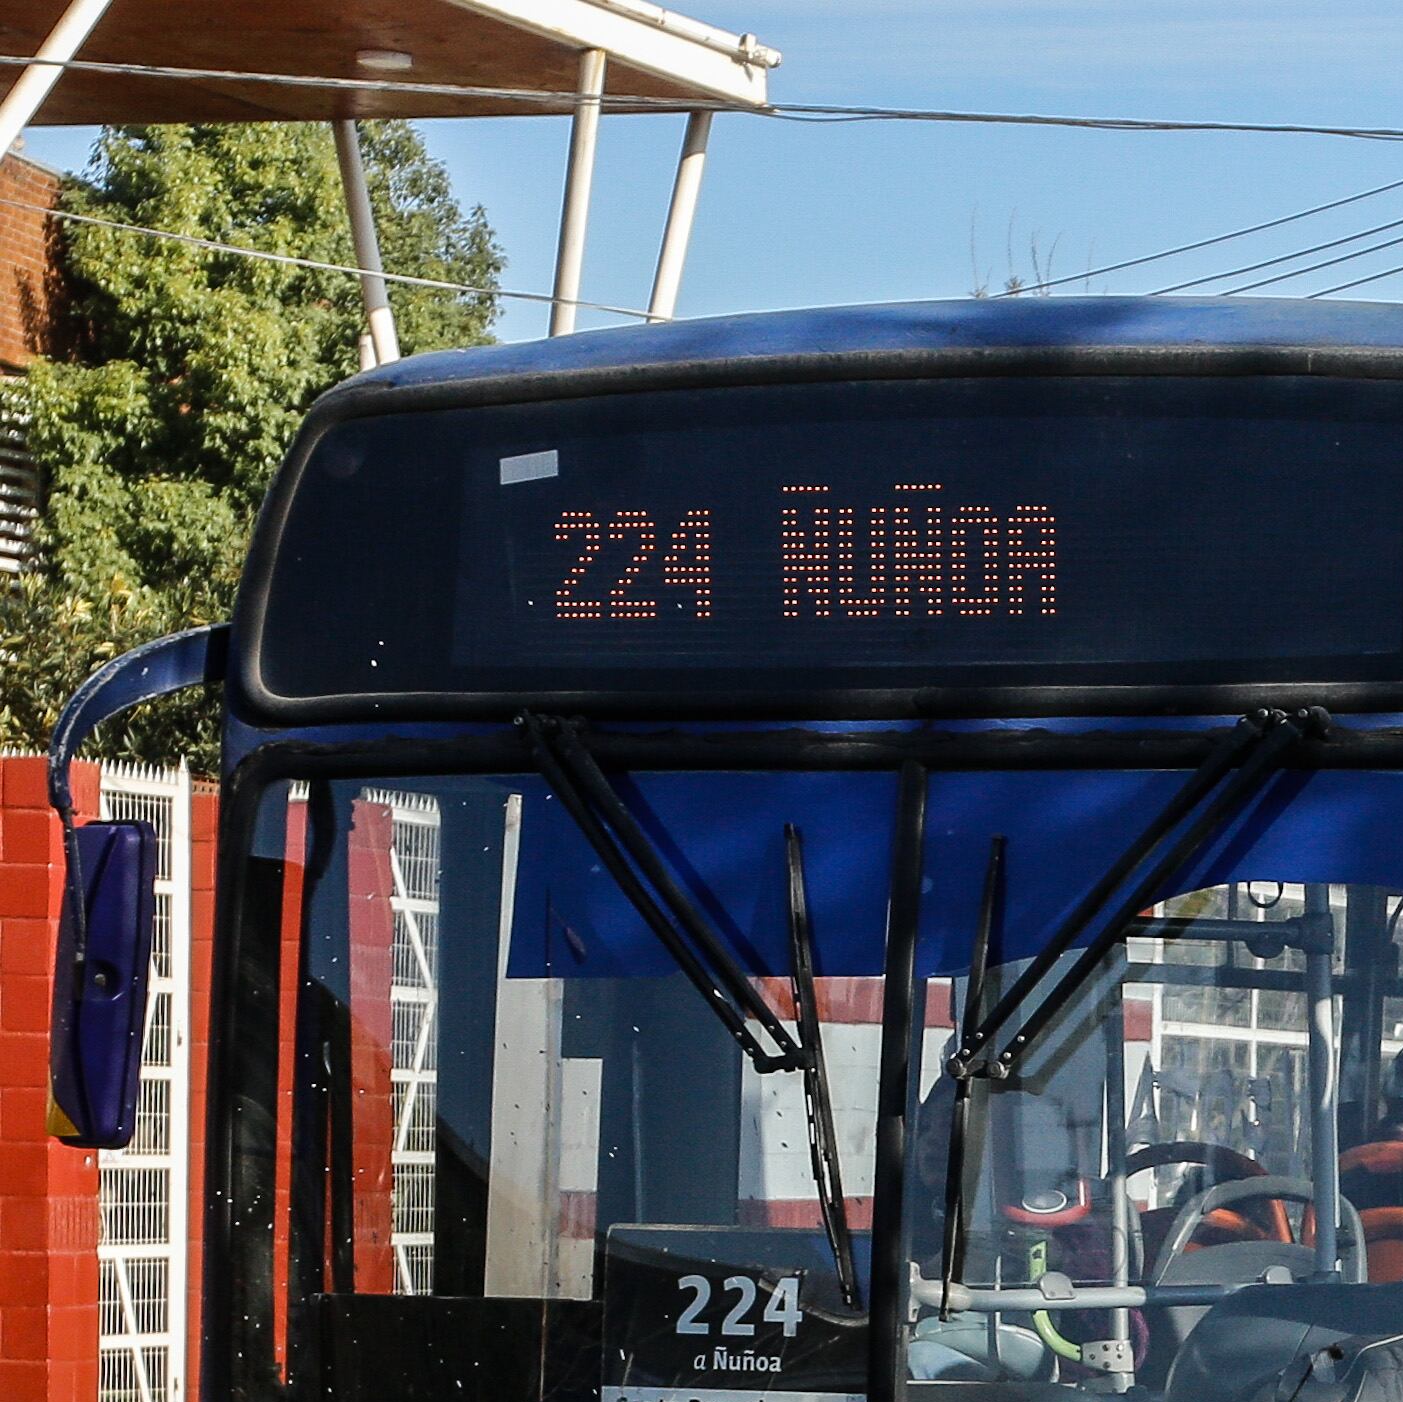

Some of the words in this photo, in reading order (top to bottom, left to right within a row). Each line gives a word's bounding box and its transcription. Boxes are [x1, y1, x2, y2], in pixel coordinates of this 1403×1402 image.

[554, 510, 711, 618] 224
[781, 483, 1056, 616] ÑUÑOA
[675, 1274, 803, 1337] 224
[693, 1353, 706, 1370] a
[713, 1346, 782, 1373] Ñuñoa
